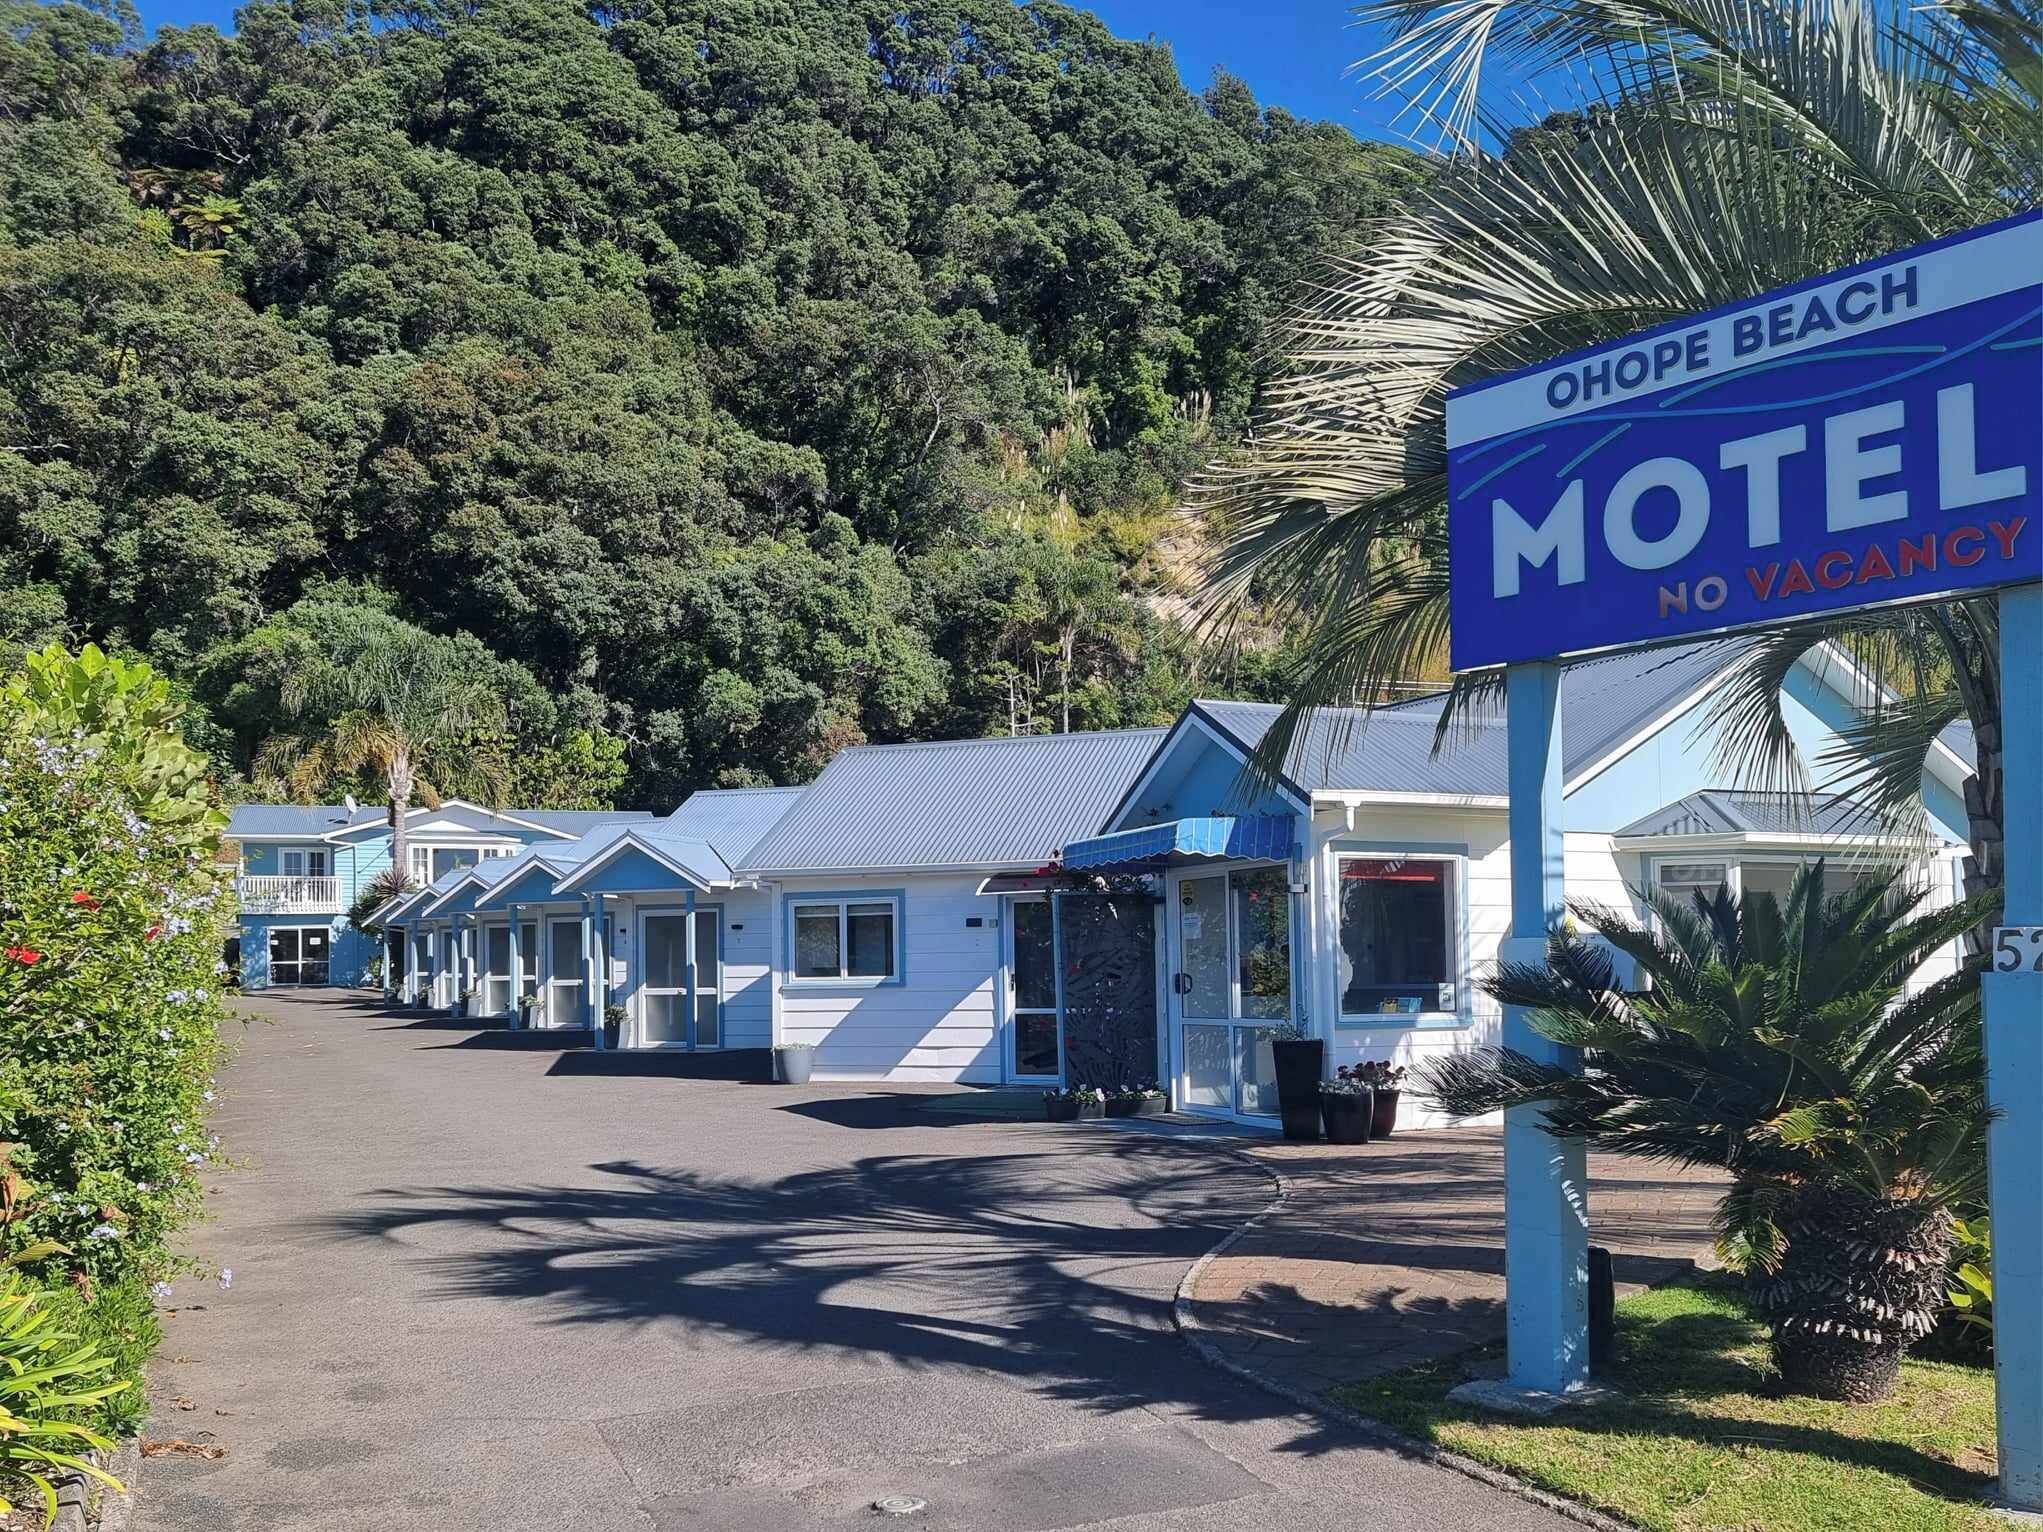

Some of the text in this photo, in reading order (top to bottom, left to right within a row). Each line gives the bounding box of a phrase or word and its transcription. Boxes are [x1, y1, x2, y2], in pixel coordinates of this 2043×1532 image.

[1546, 266, 1919, 409] OHOPE BEACH
[1493, 383, 2027, 598] MOTEL
[1659, 516, 2027, 618] NO VACANCY
